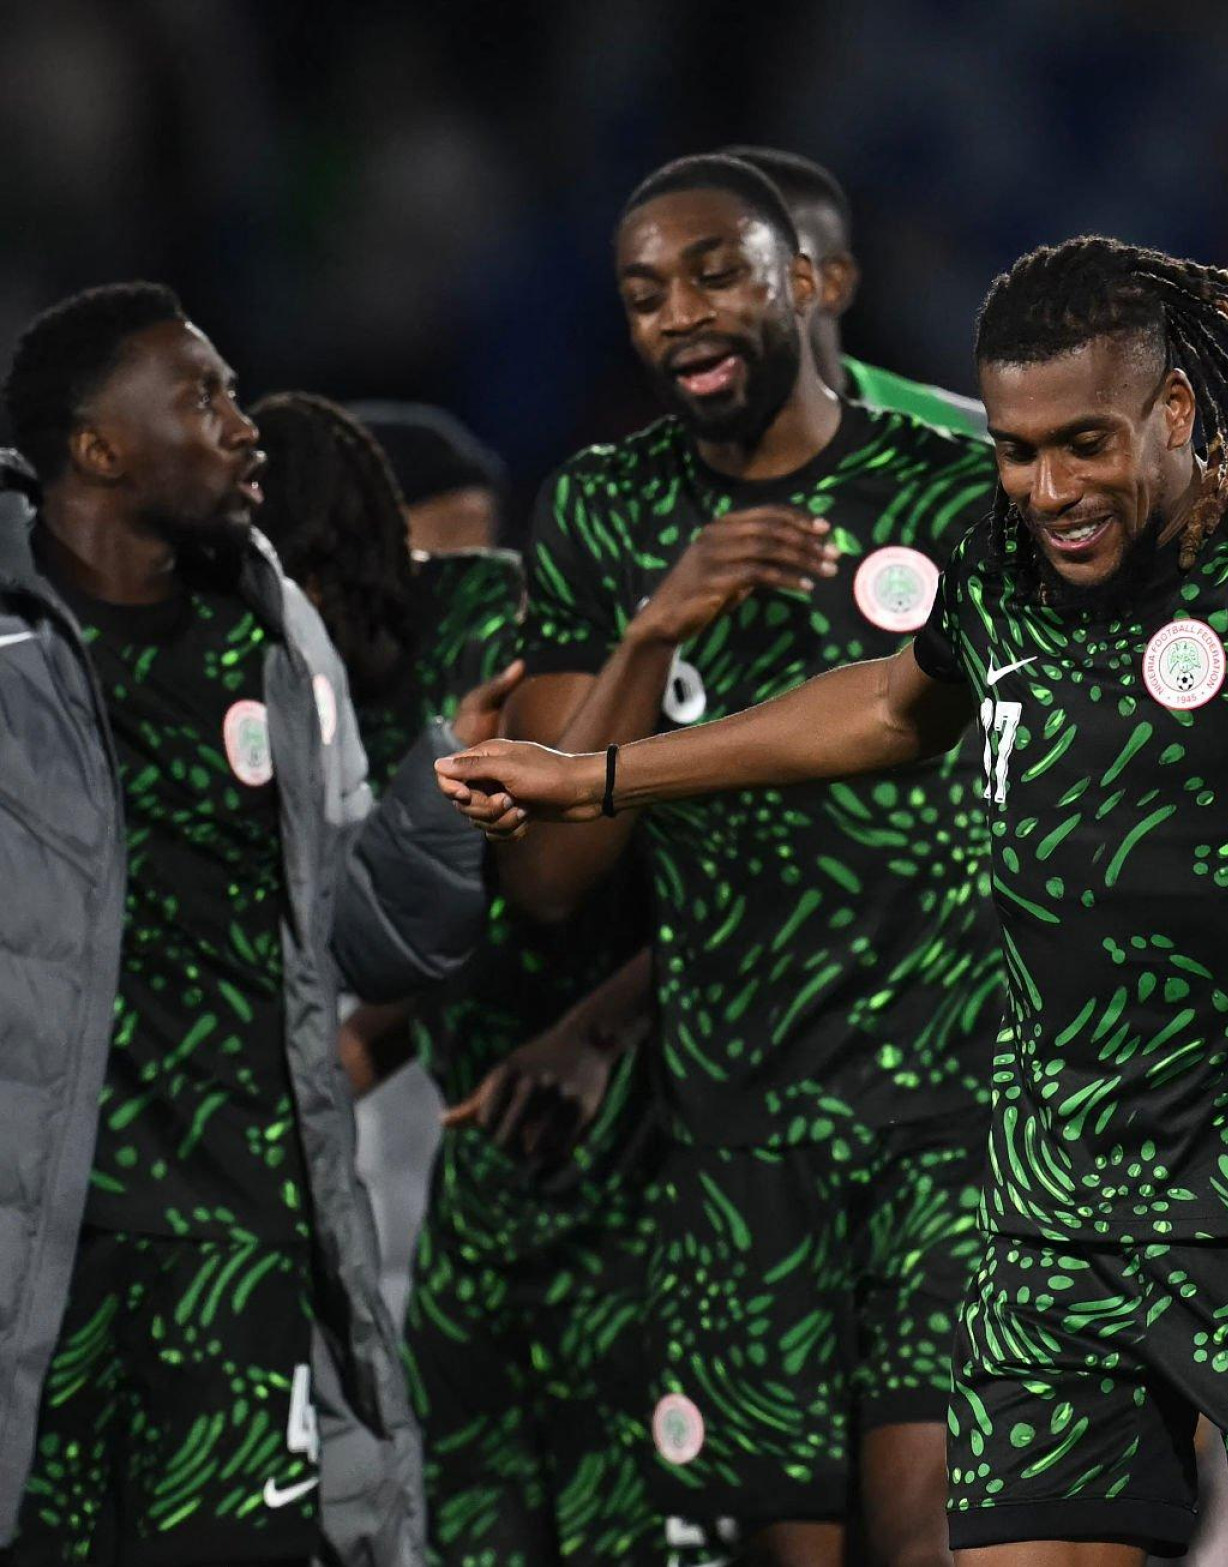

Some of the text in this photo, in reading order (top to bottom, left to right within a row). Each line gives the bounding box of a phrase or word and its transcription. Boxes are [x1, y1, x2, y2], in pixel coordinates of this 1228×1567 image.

[1148, 624, 1220, 695] NIGERIA FOOTBALL FEDERATION
[980, 697, 1022, 803] 17
